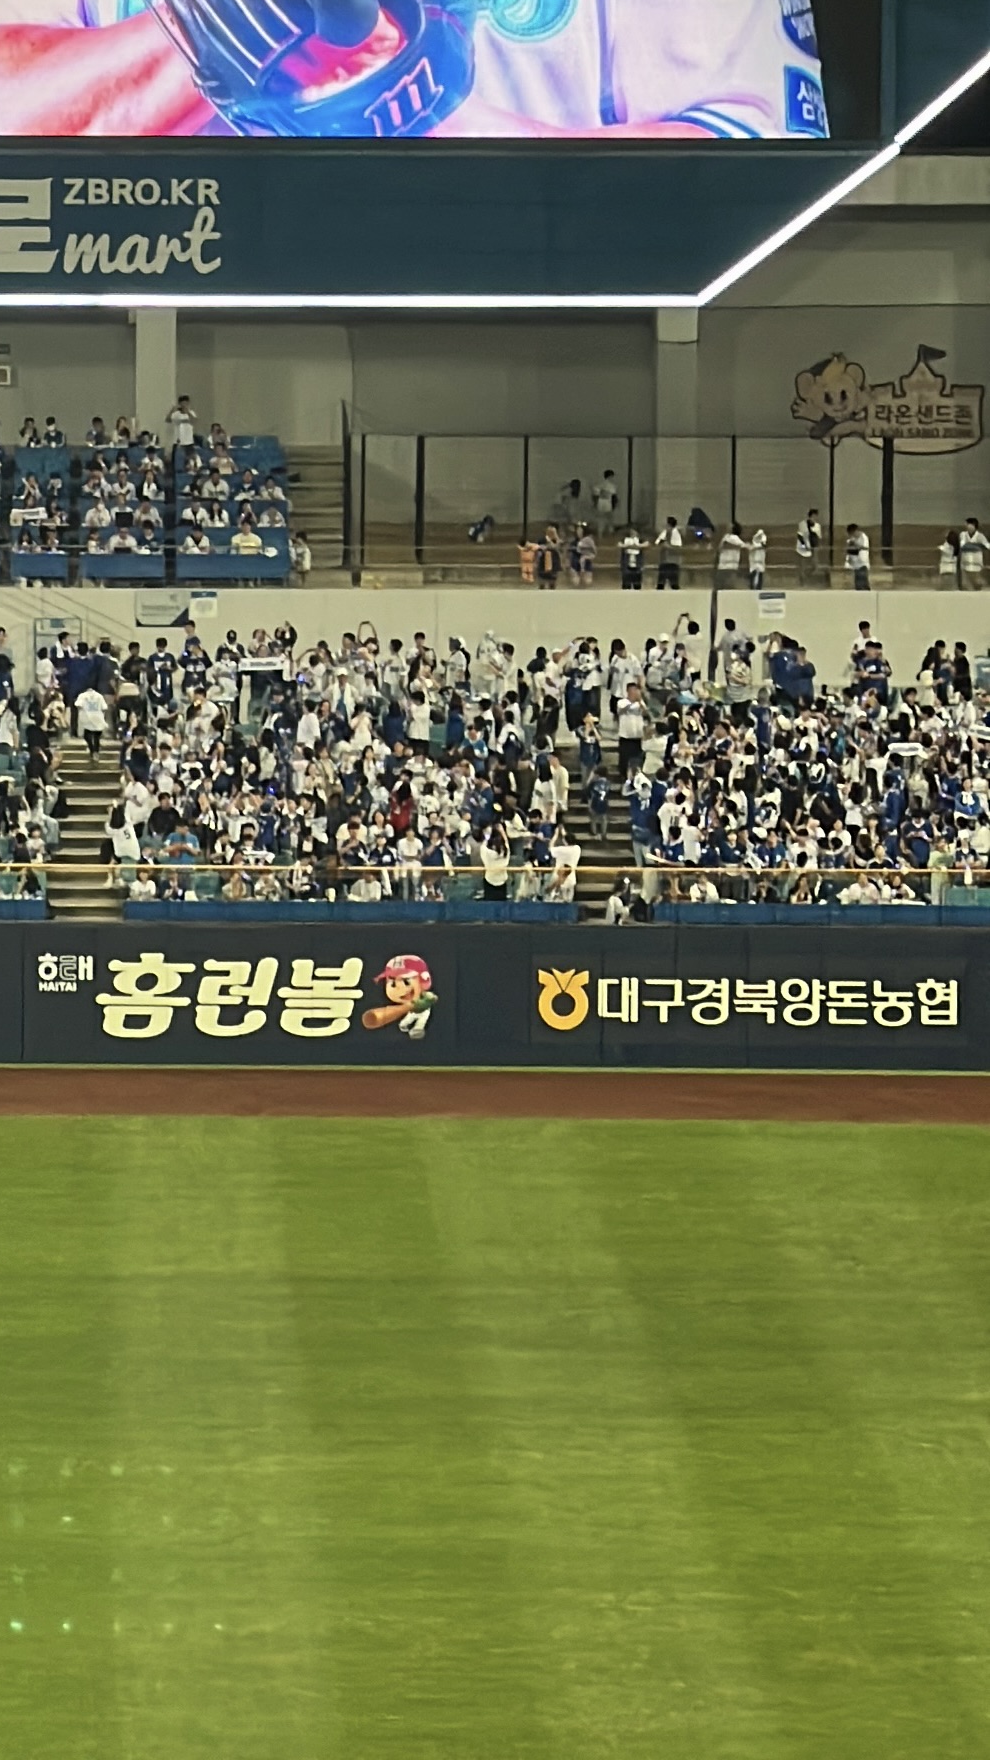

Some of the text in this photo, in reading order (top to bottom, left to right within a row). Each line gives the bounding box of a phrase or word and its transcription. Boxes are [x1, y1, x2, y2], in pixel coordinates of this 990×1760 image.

[63, 178, 221, 206] ZBRO.KR
[63, 206, 222, 274] mart
[37, 952, 94, 981] 해태
[38, 981, 78, 992] HAITAI
[95, 952, 364, 1039] 홈런볼
[597, 976, 959, 1027] 대구경북양돈농협
